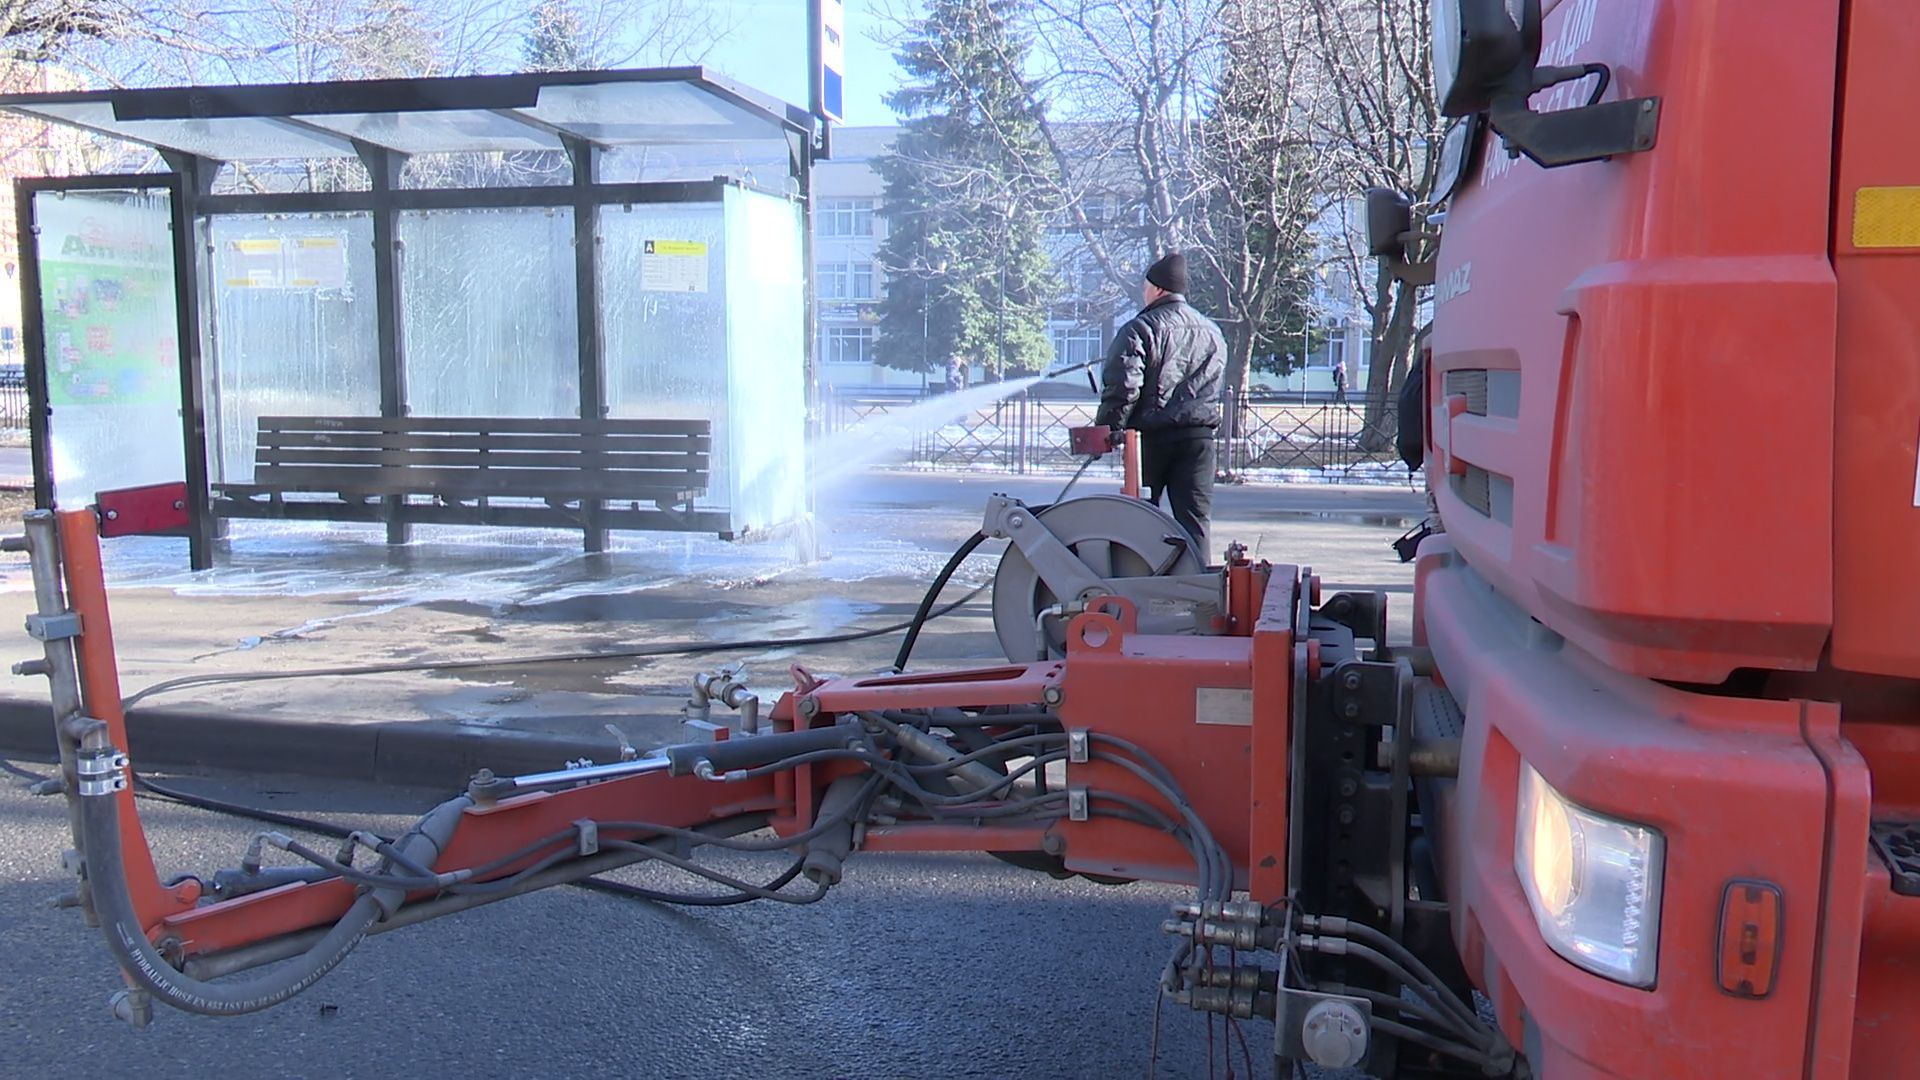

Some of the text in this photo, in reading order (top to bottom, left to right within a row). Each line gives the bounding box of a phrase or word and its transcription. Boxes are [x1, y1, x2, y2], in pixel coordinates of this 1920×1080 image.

[1440, 261, 1472, 304] MAZ
[132, 948, 170, 989] HYDRAULIC
[168, 984, 193, 1003] HOSE
